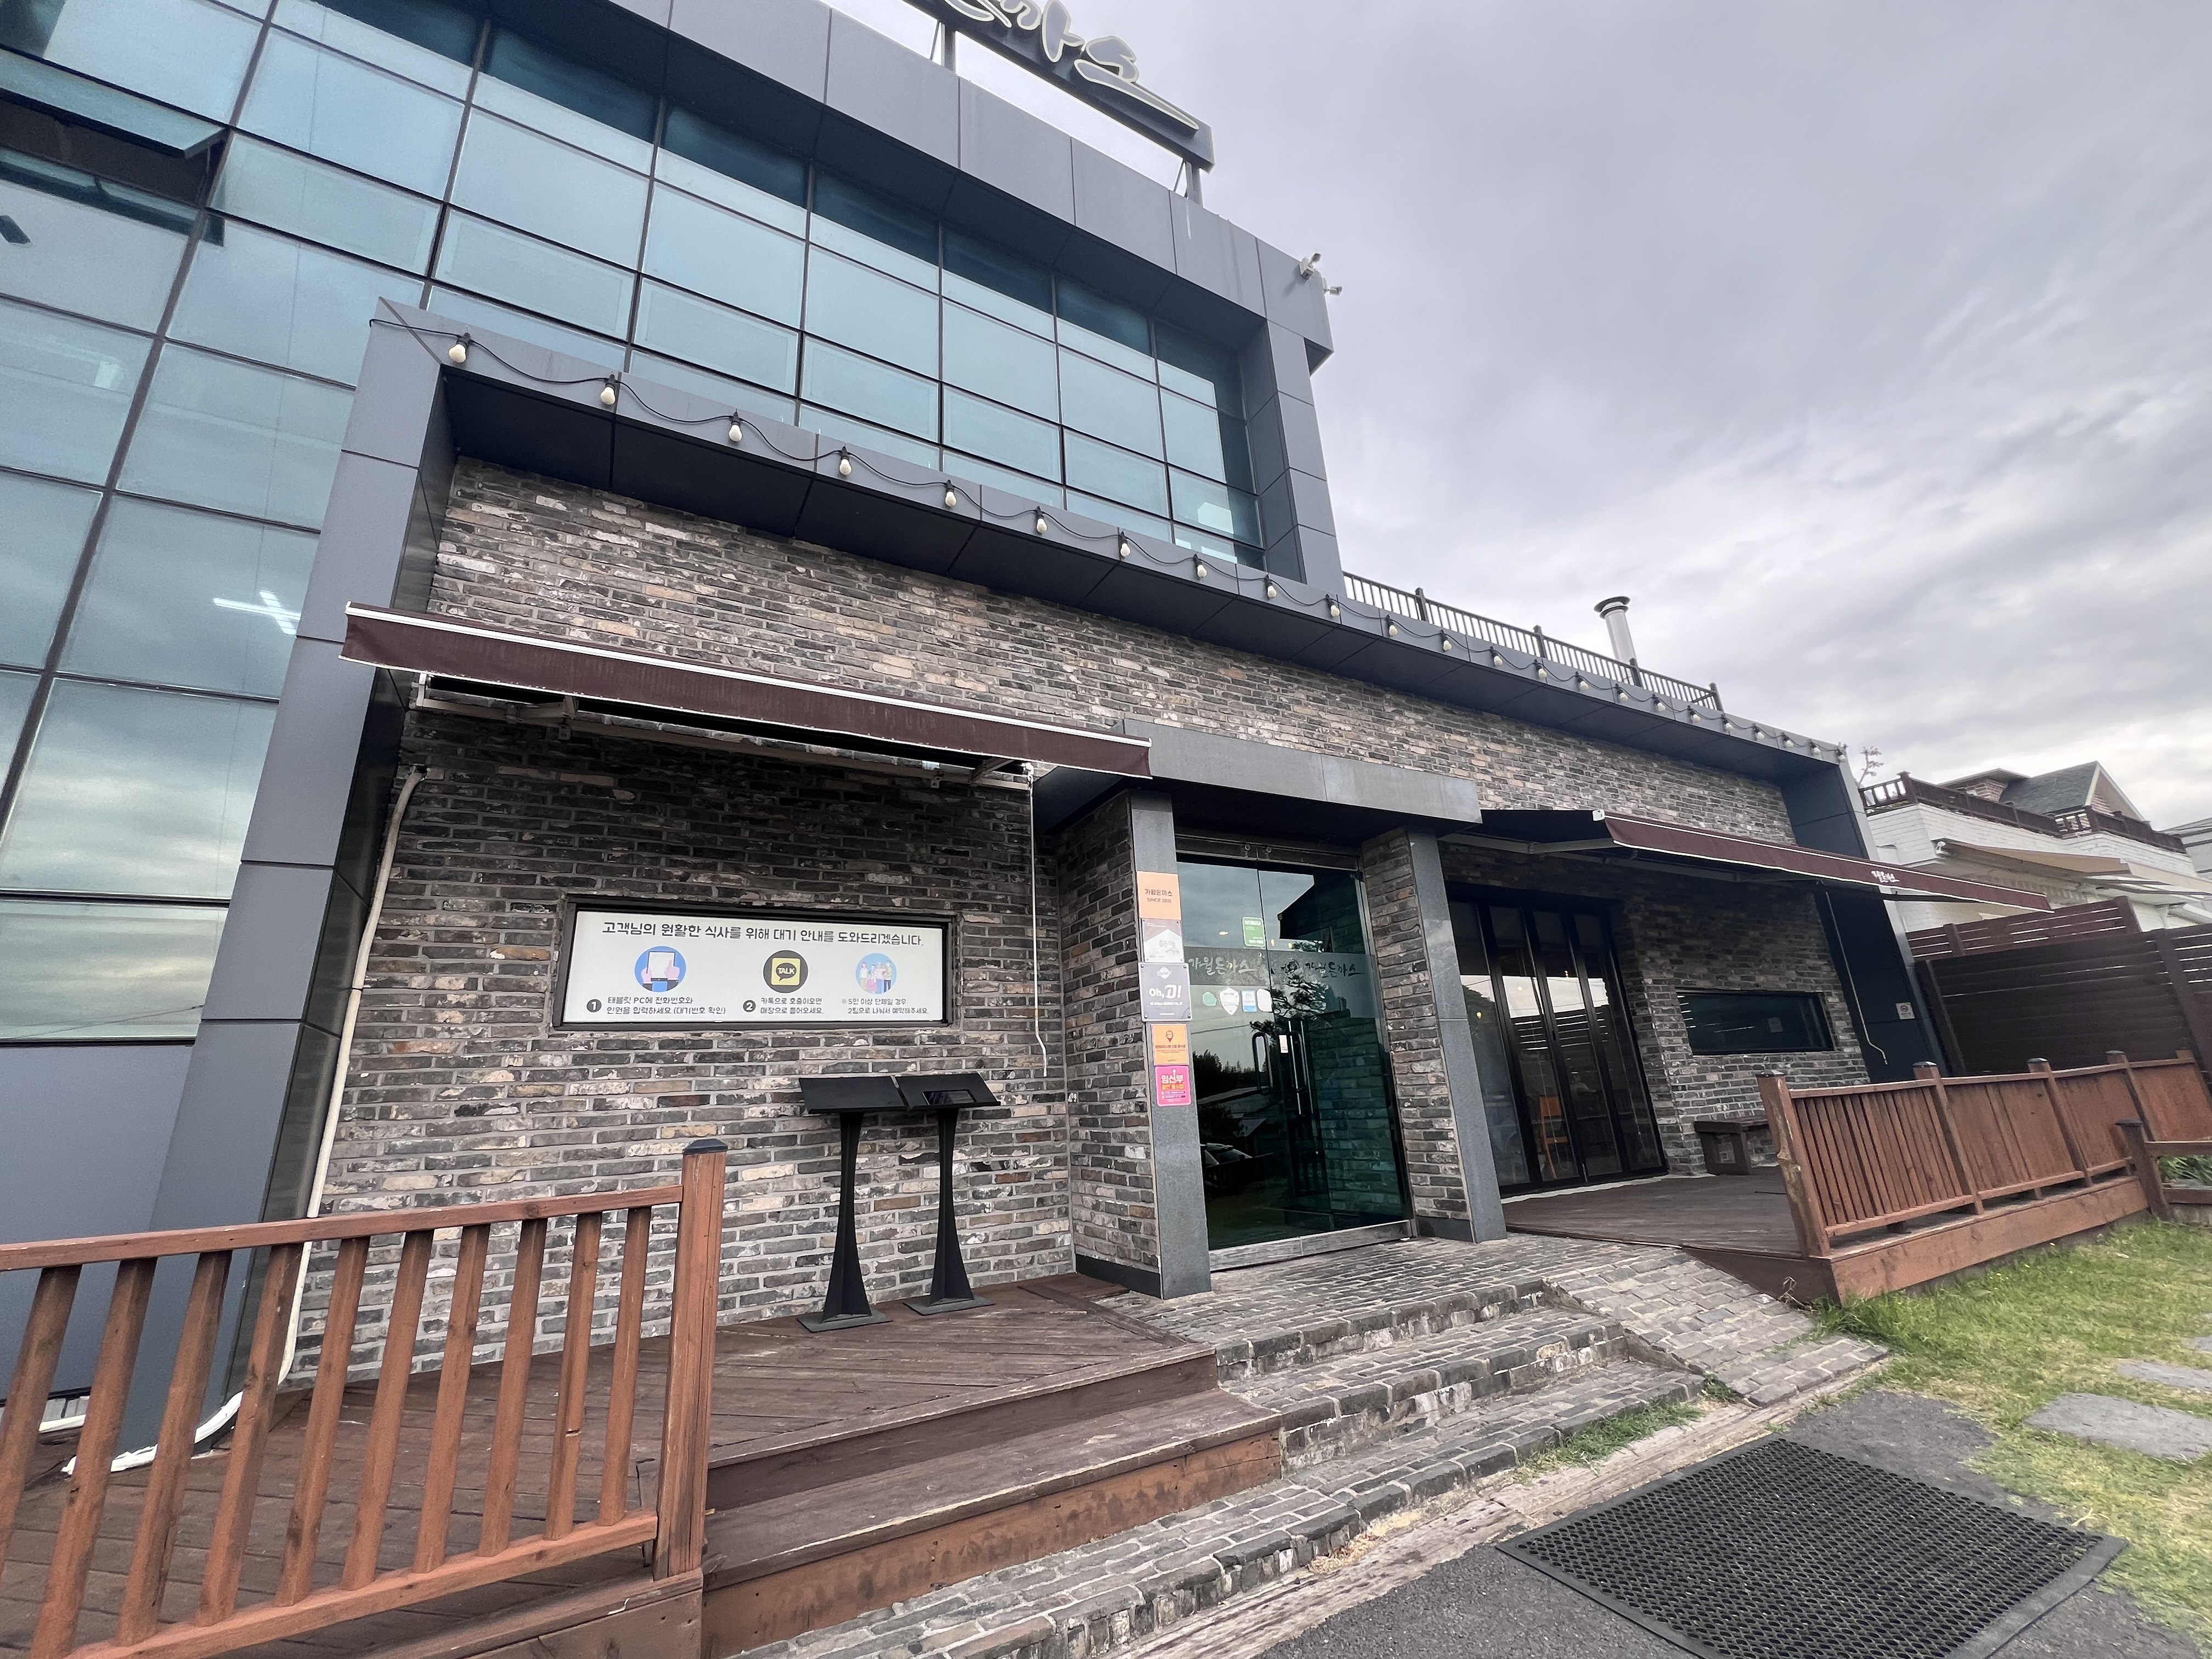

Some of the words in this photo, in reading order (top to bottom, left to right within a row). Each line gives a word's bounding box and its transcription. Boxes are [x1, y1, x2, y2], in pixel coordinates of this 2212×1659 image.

[602, 921, 656, 935] 고객님의
[661, 923, 701, 938] 원활한
[704, 926, 742, 939] 식사를
[745, 927, 770, 940] 위해
[773, 928, 796, 941] 대기
[800, 929, 834, 943] 안내를
[838, 931, 924, 946] 도와드리겠습니다.
[607, 996, 631, 1005] 태블릿
[633, 996, 653, 1005] PC에
[655, 996, 693, 1005] 전화번호와
[606, 1006, 630, 1014] 인원을
[708, 1006, 726, 1014] 확인)
[1161, 1069, 1184, 1084] 임신부
